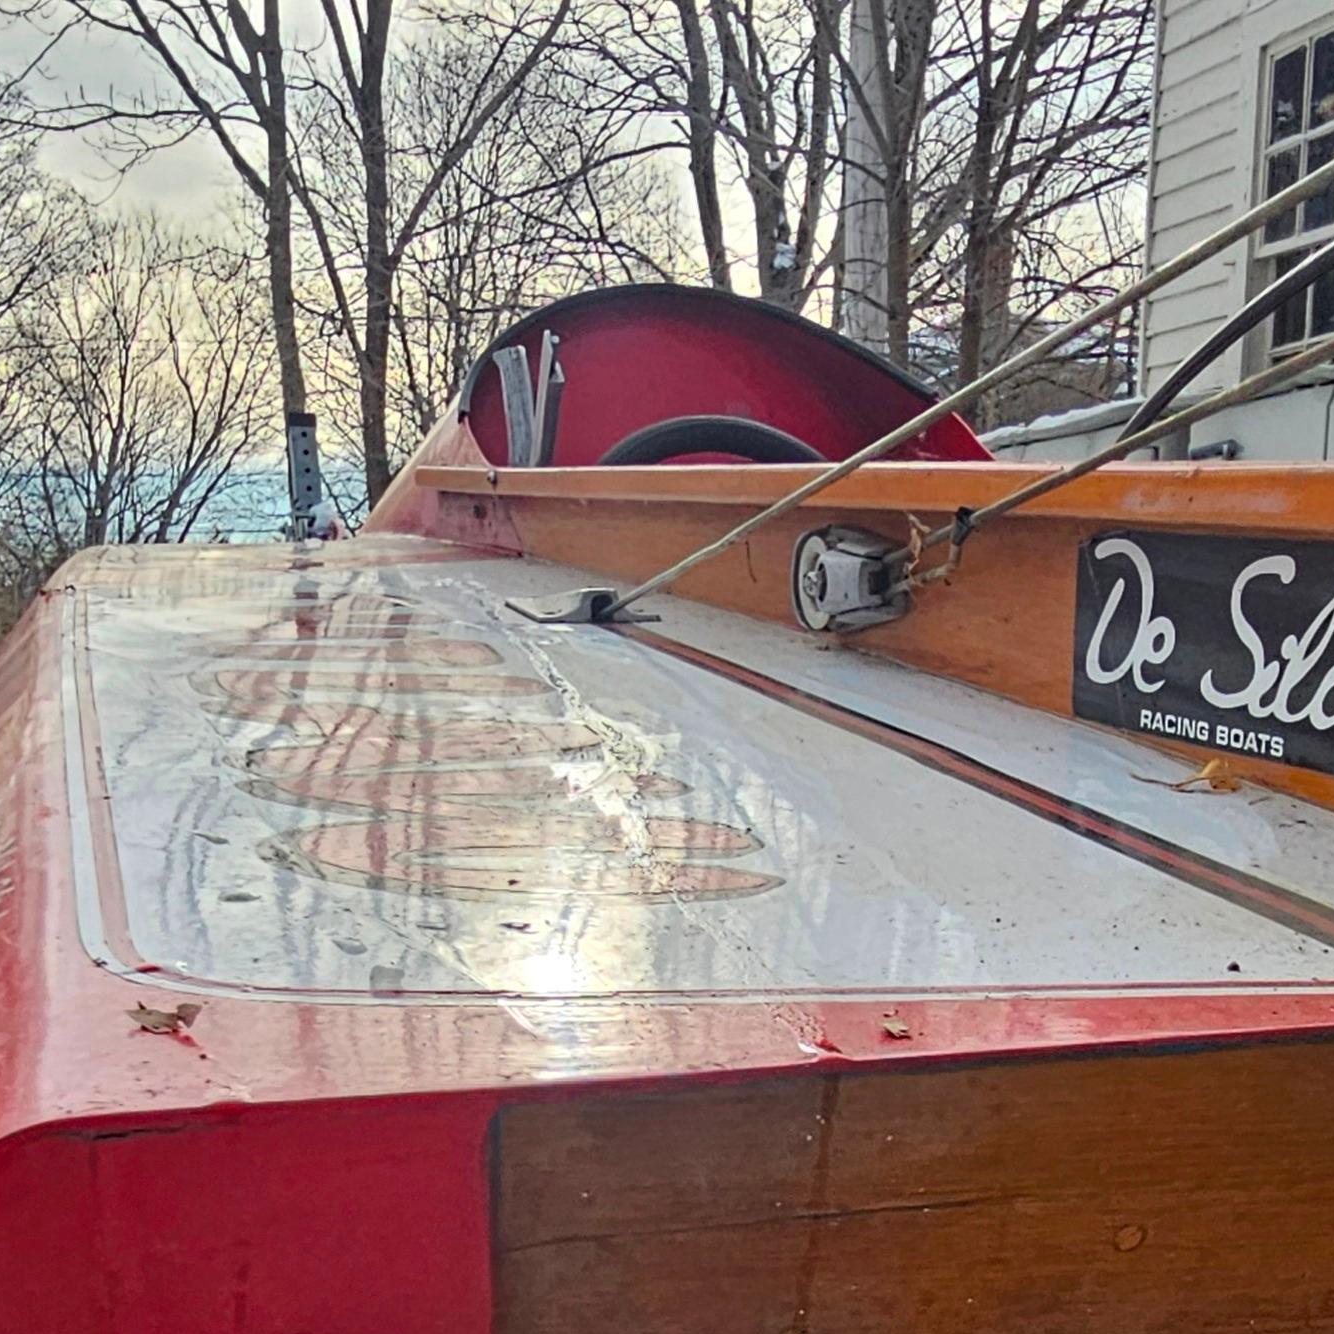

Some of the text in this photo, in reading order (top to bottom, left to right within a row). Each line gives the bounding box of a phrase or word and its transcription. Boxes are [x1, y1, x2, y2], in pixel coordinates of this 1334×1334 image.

[1085, 538, 1176, 693] De
[1139, 708, 1285, 758] RACING BOATS
